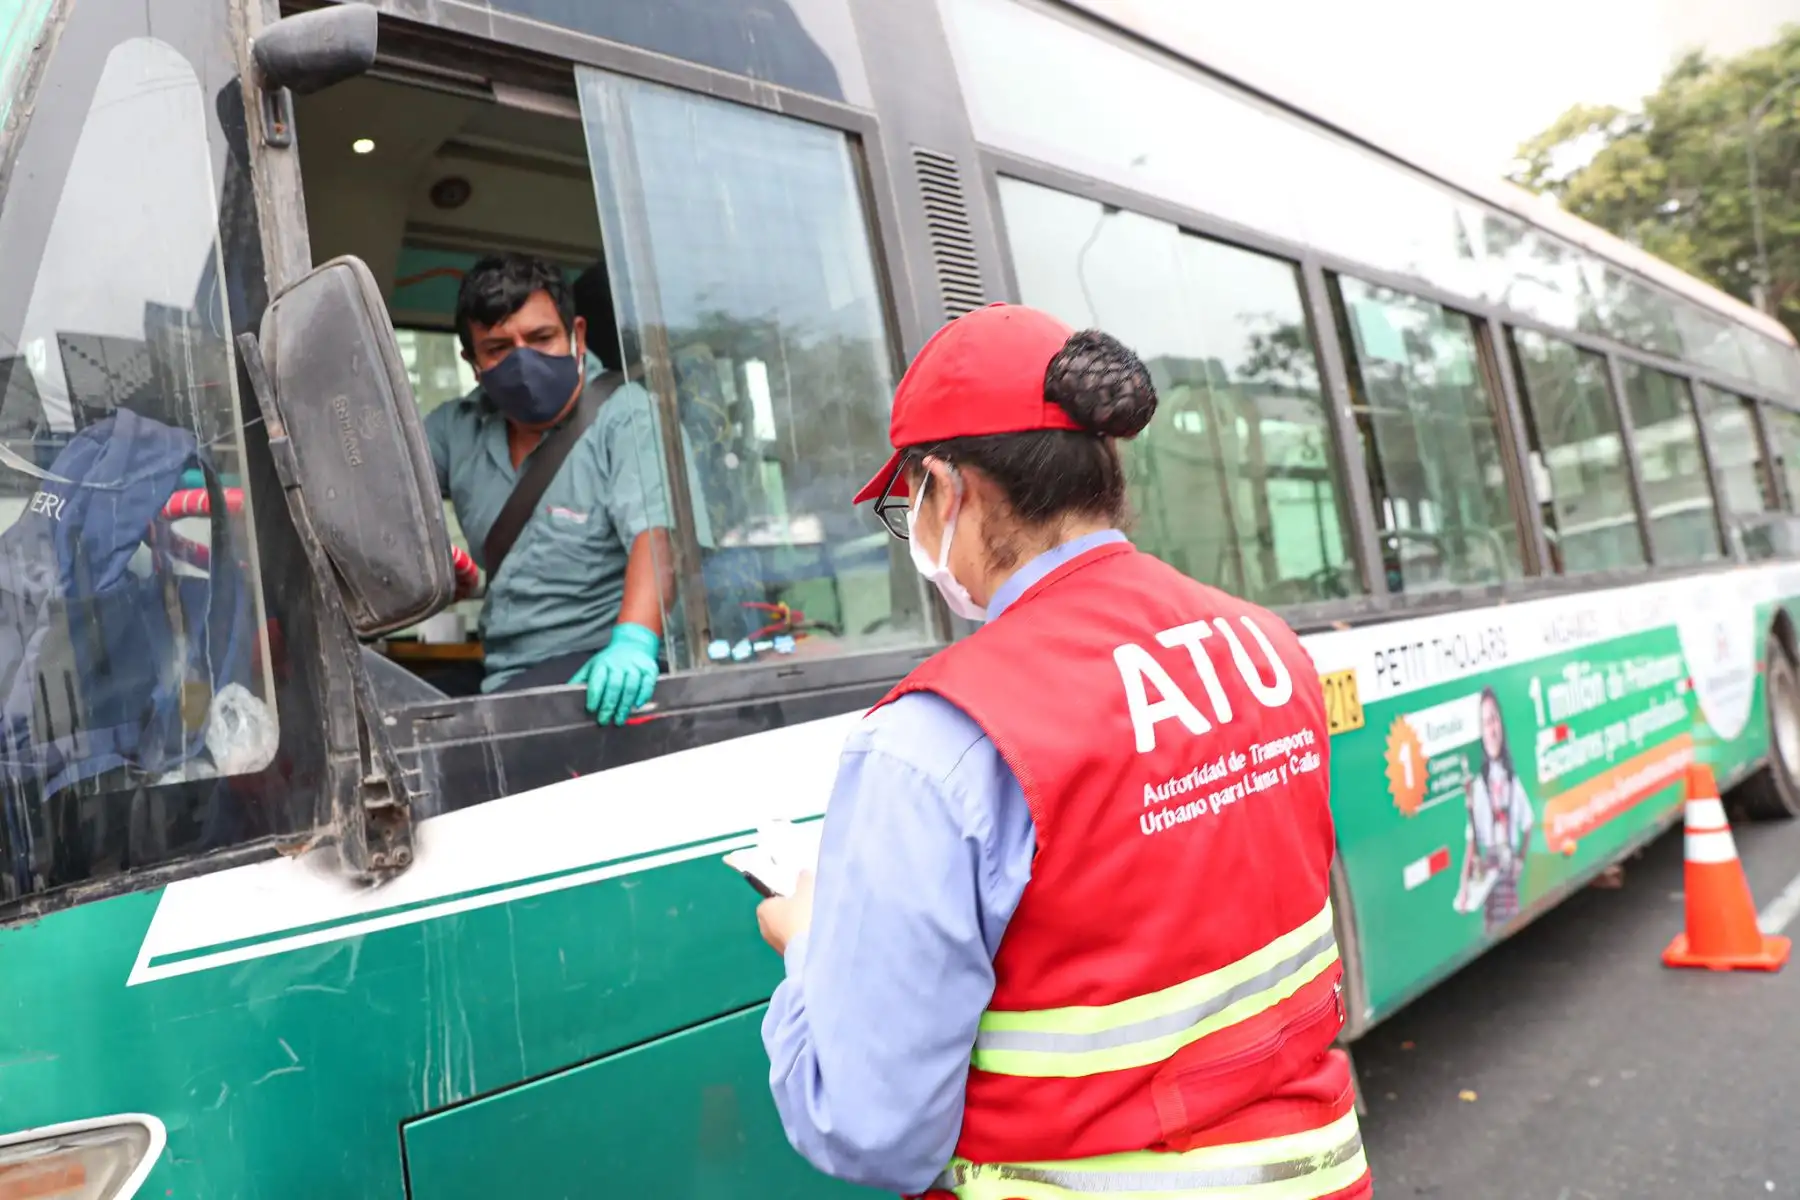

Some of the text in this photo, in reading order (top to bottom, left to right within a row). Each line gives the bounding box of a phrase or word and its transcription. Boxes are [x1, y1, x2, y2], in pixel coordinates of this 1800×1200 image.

[1113, 615, 1293, 753] ATU
[1374, 642, 1424, 690] PETIT
[1529, 676, 1545, 727] 1
[1143, 728, 1316, 808] Autoridad de Transporte
[1398, 741, 1414, 789] 1
[1140, 805, 1208, 835] Urbano
[1208, 781, 1245, 815] para
[1243, 771, 1280, 795] Lima
[1279, 763, 1288, 785] y
